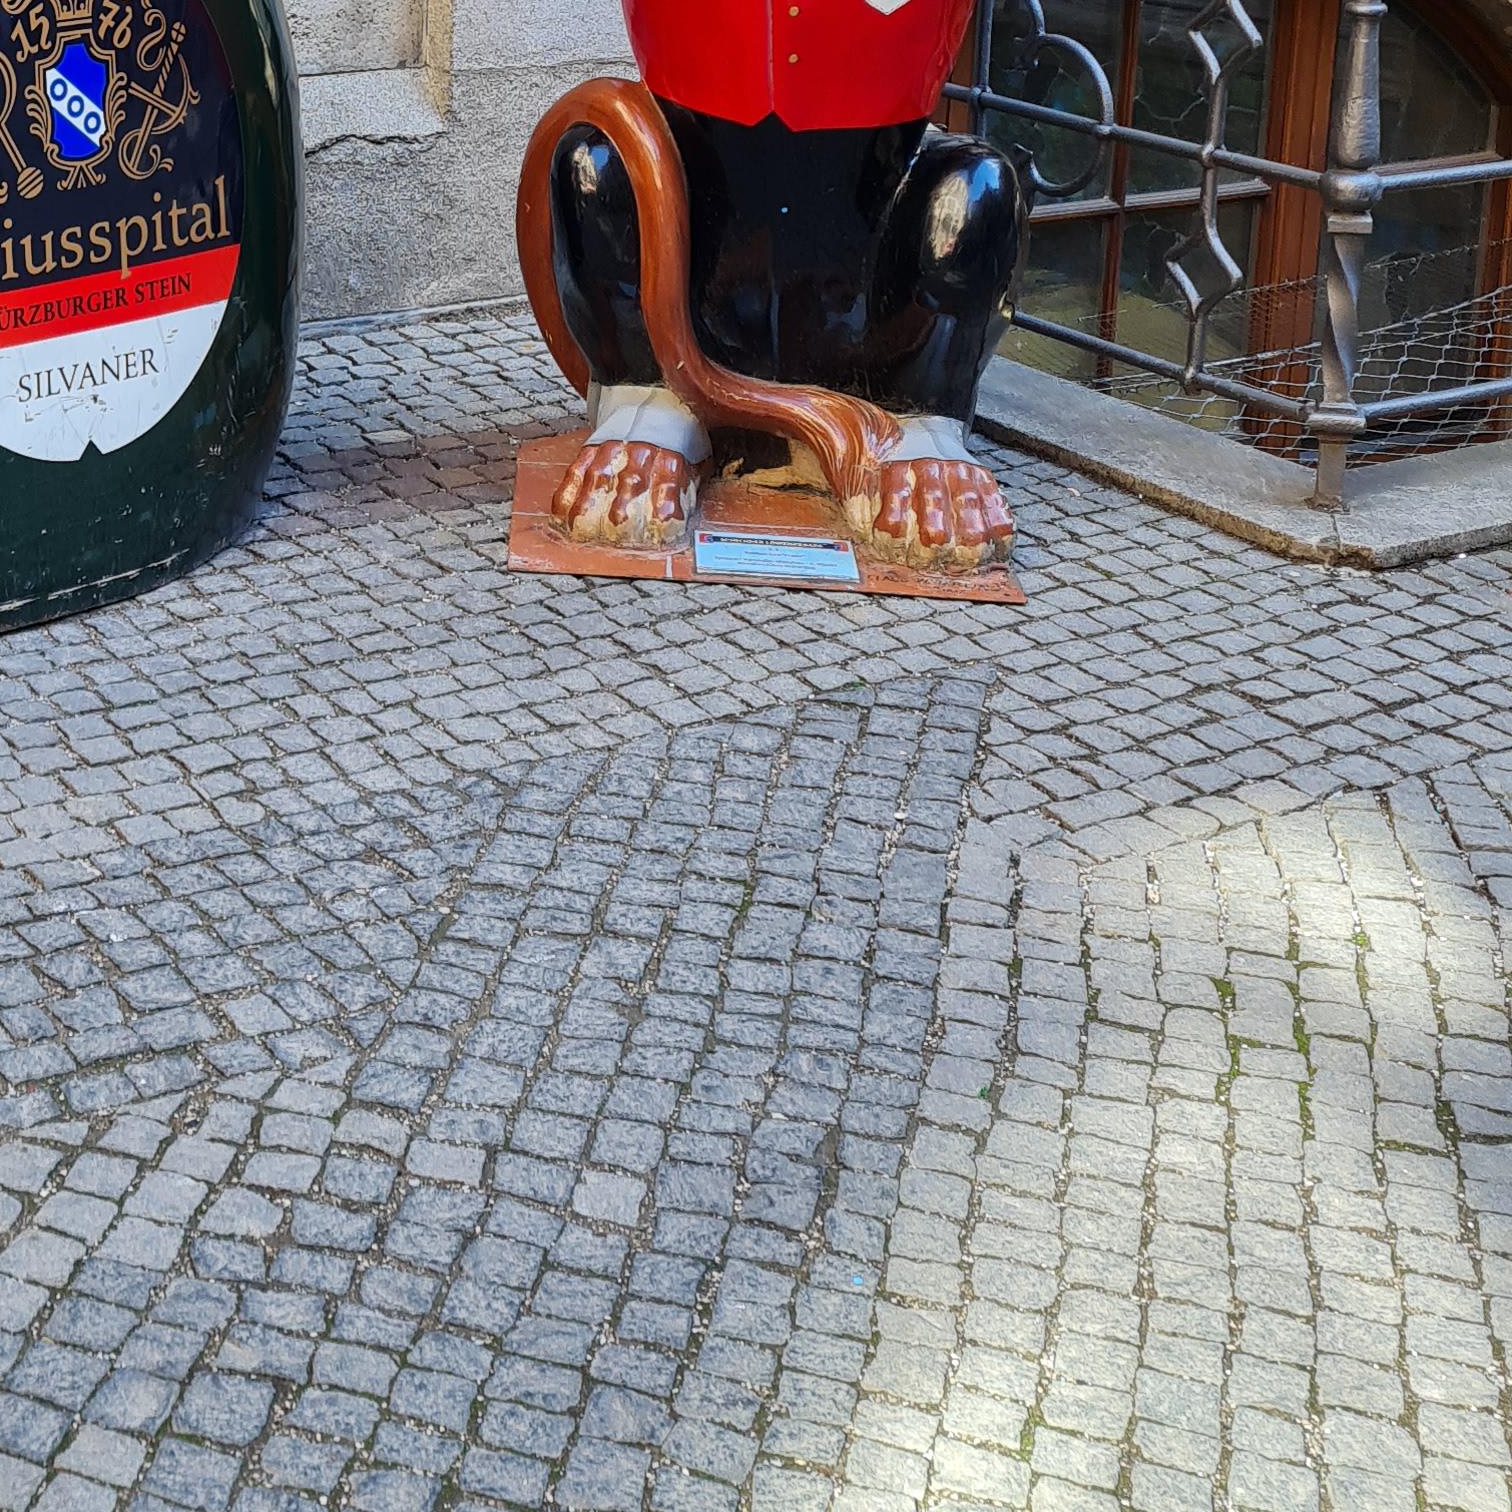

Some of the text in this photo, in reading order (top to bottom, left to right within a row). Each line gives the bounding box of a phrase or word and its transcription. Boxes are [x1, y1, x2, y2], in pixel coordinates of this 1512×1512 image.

[10, 2, 52, 63] 15
[134, 272, 192, 304] STEIN
[18, 347, 160, 403] SILVANER
